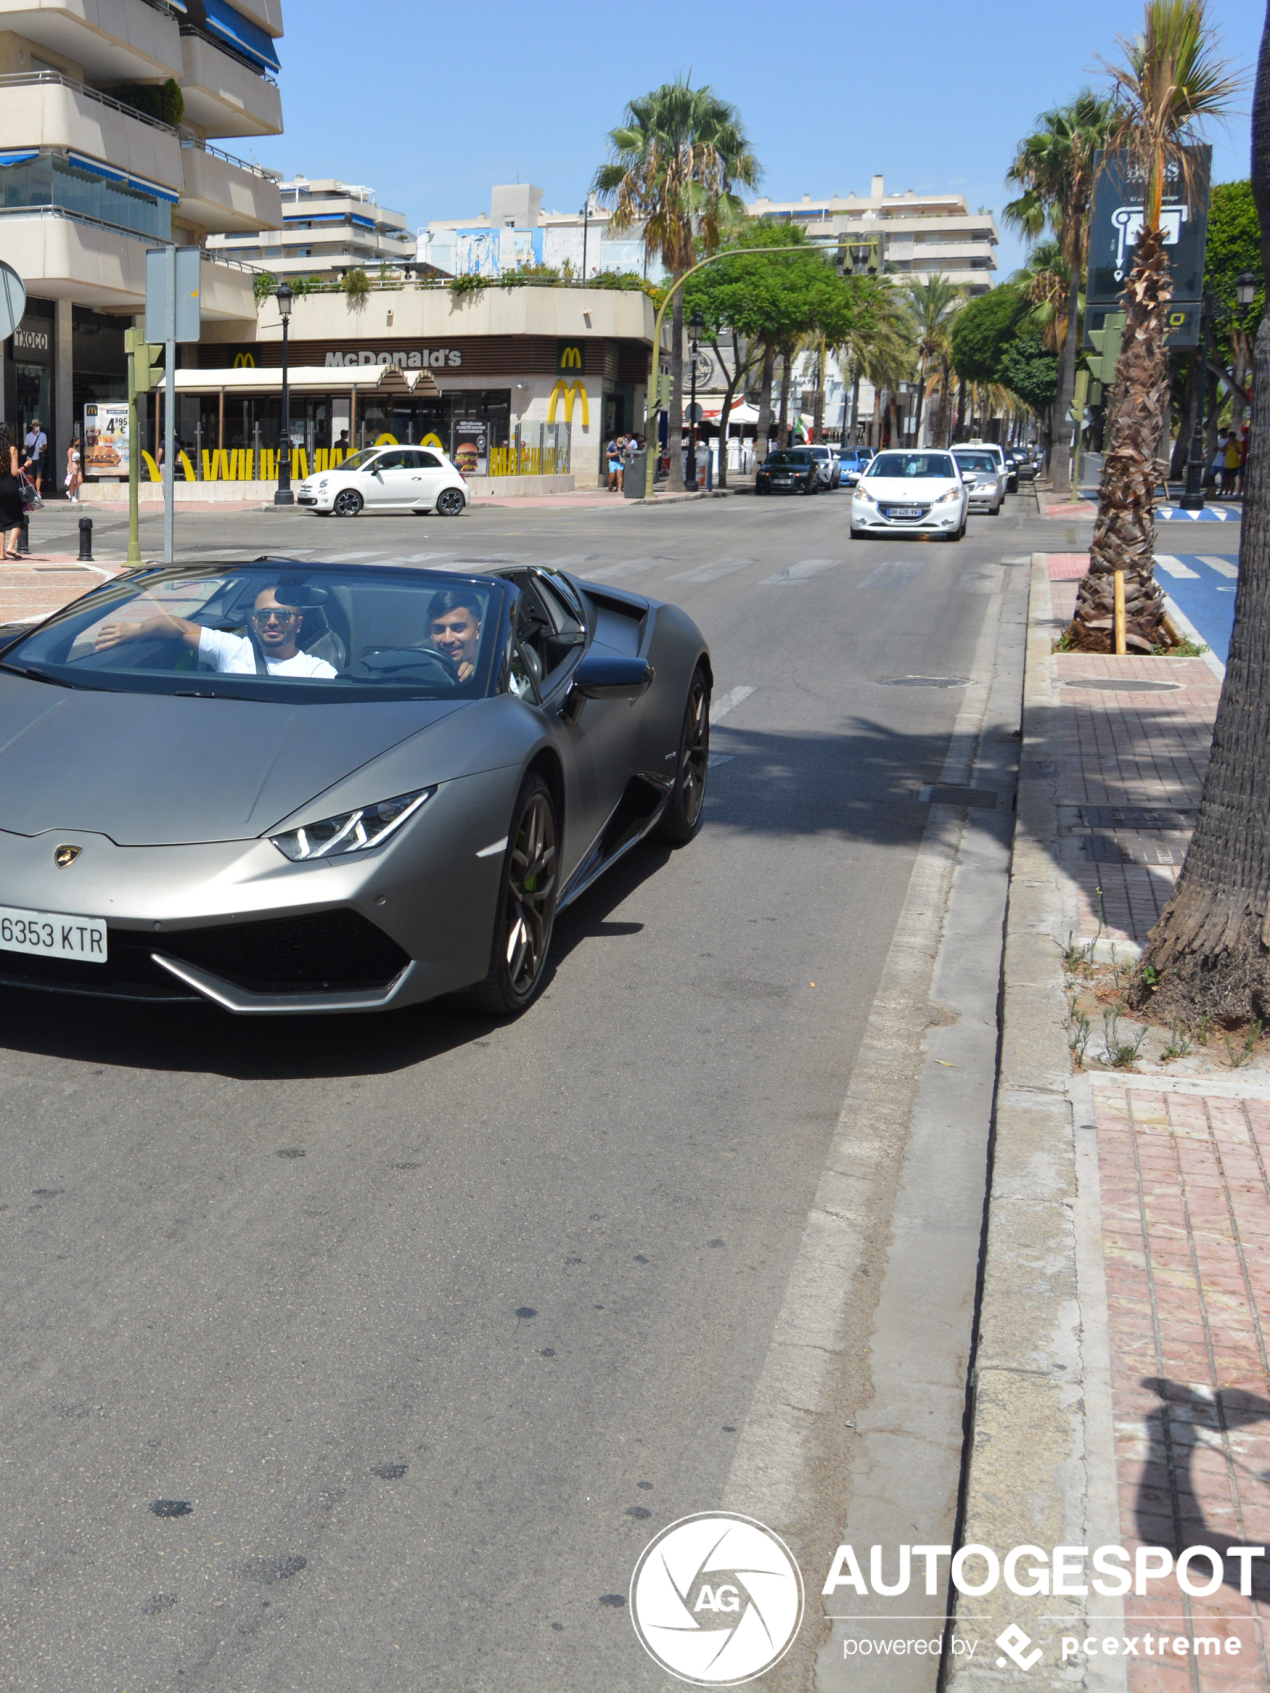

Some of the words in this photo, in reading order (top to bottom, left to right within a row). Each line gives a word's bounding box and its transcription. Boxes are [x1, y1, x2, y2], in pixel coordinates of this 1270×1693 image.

[14, 330, 48, 350] TXOCO
[324, 349, 462, 368] McDonald's
[1, 918, 54, 948] 6353
[62, 925, 102, 953] KTR
